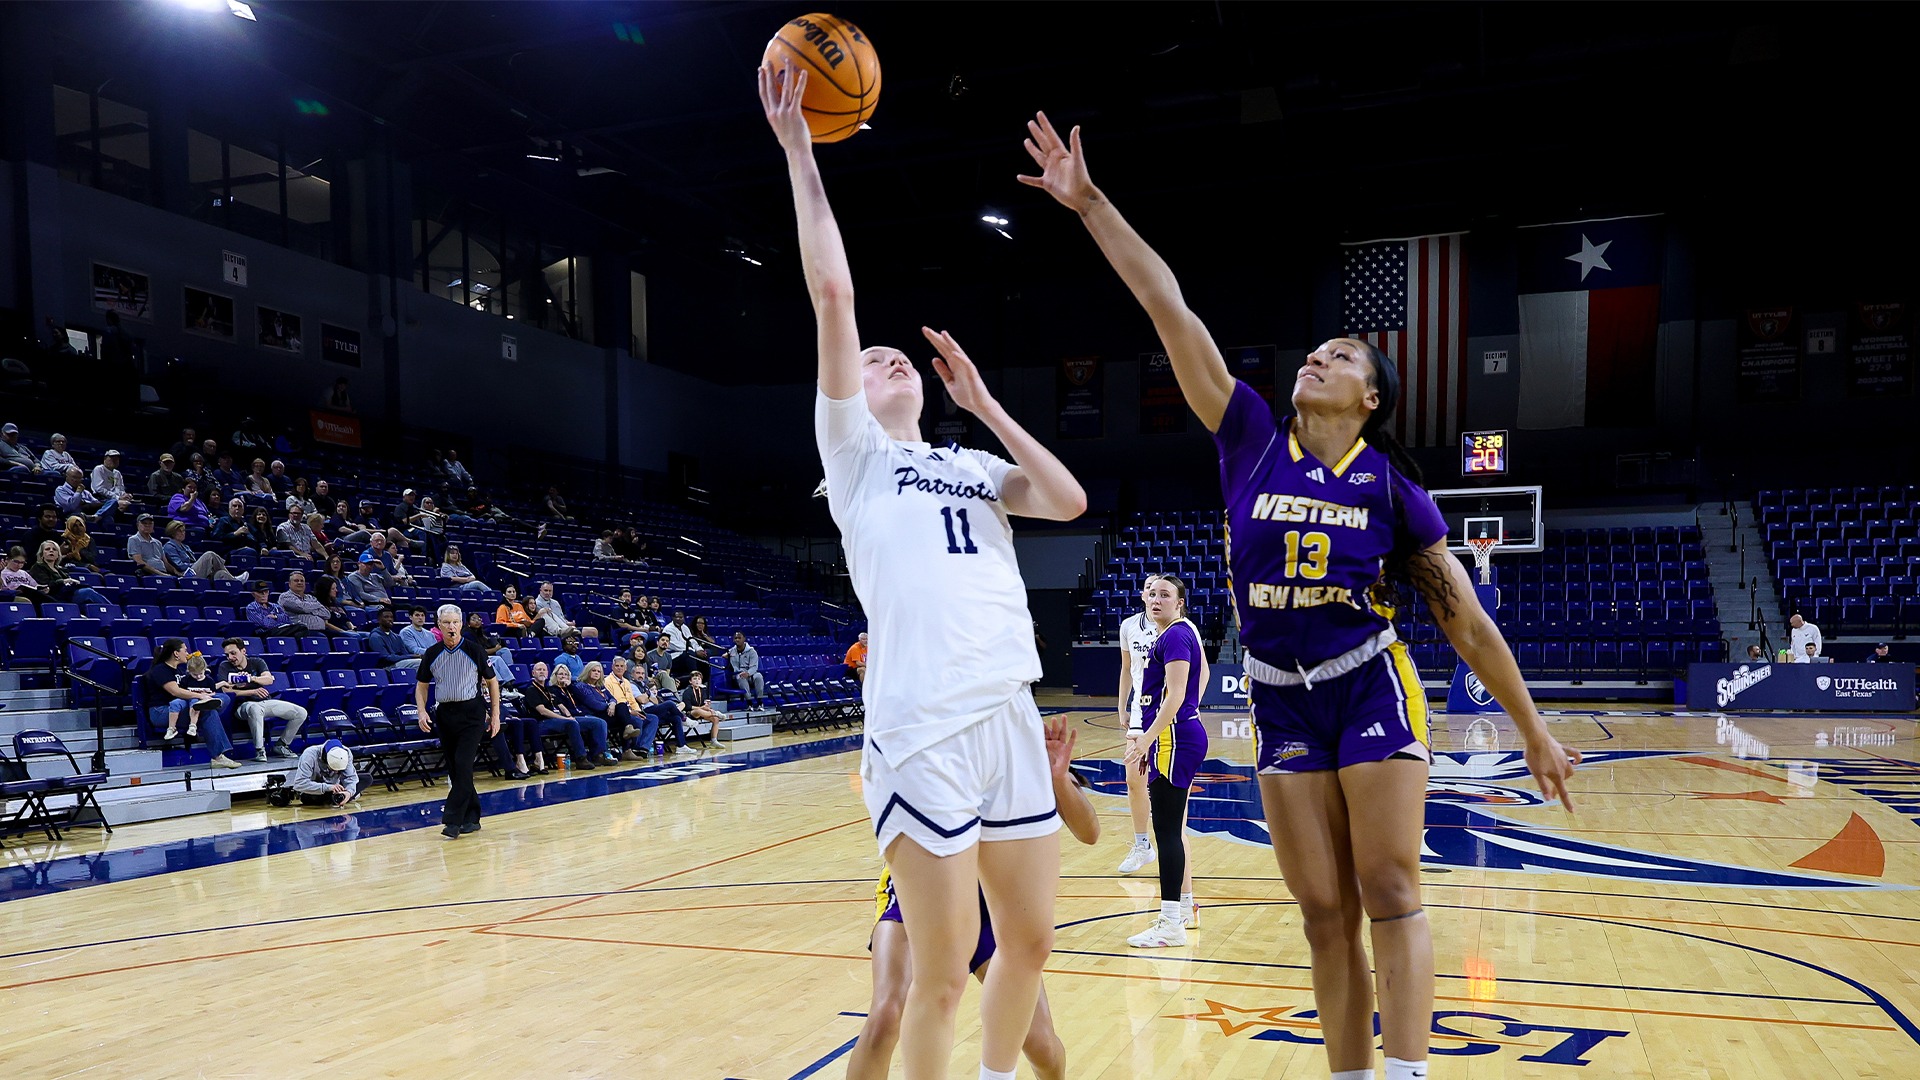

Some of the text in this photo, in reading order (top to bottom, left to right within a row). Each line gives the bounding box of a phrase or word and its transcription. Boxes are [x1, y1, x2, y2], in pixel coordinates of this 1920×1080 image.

[224, 253, 246, 266] SECTION
[233, 267, 239, 282] 4
[1861, 335, 1903, 343] WOMEN'S
[334, 340, 359, 354] TYLER
[507, 346, 512, 357] 5
[1818, 340, 1824, 351] 8
[1852, 342, 1908, 351] BASKETBALL
[1741, 358, 1796, 367] CHAMPIONS
[1855, 355, 1893, 364] SWEET
[1493, 361, 1499, 371] 7
[1474, 435, 1502, 449] 2:28
[1472, 449, 1498, 471] 20
[894, 466, 998, 502] Patriots
[1348, 473, 1372, 485] LSC
[1251, 492, 1369, 531] WESTERN
[940, 506, 978, 554] 11
[1284, 530, 1331, 580] 13
[1248, 582, 1361, 610] NEW MEXIC
[1833, 678, 1898, 690] UTHealth
[1835, 690, 1851, 700] East
[21, 735, 56, 744] PATRIOTS
